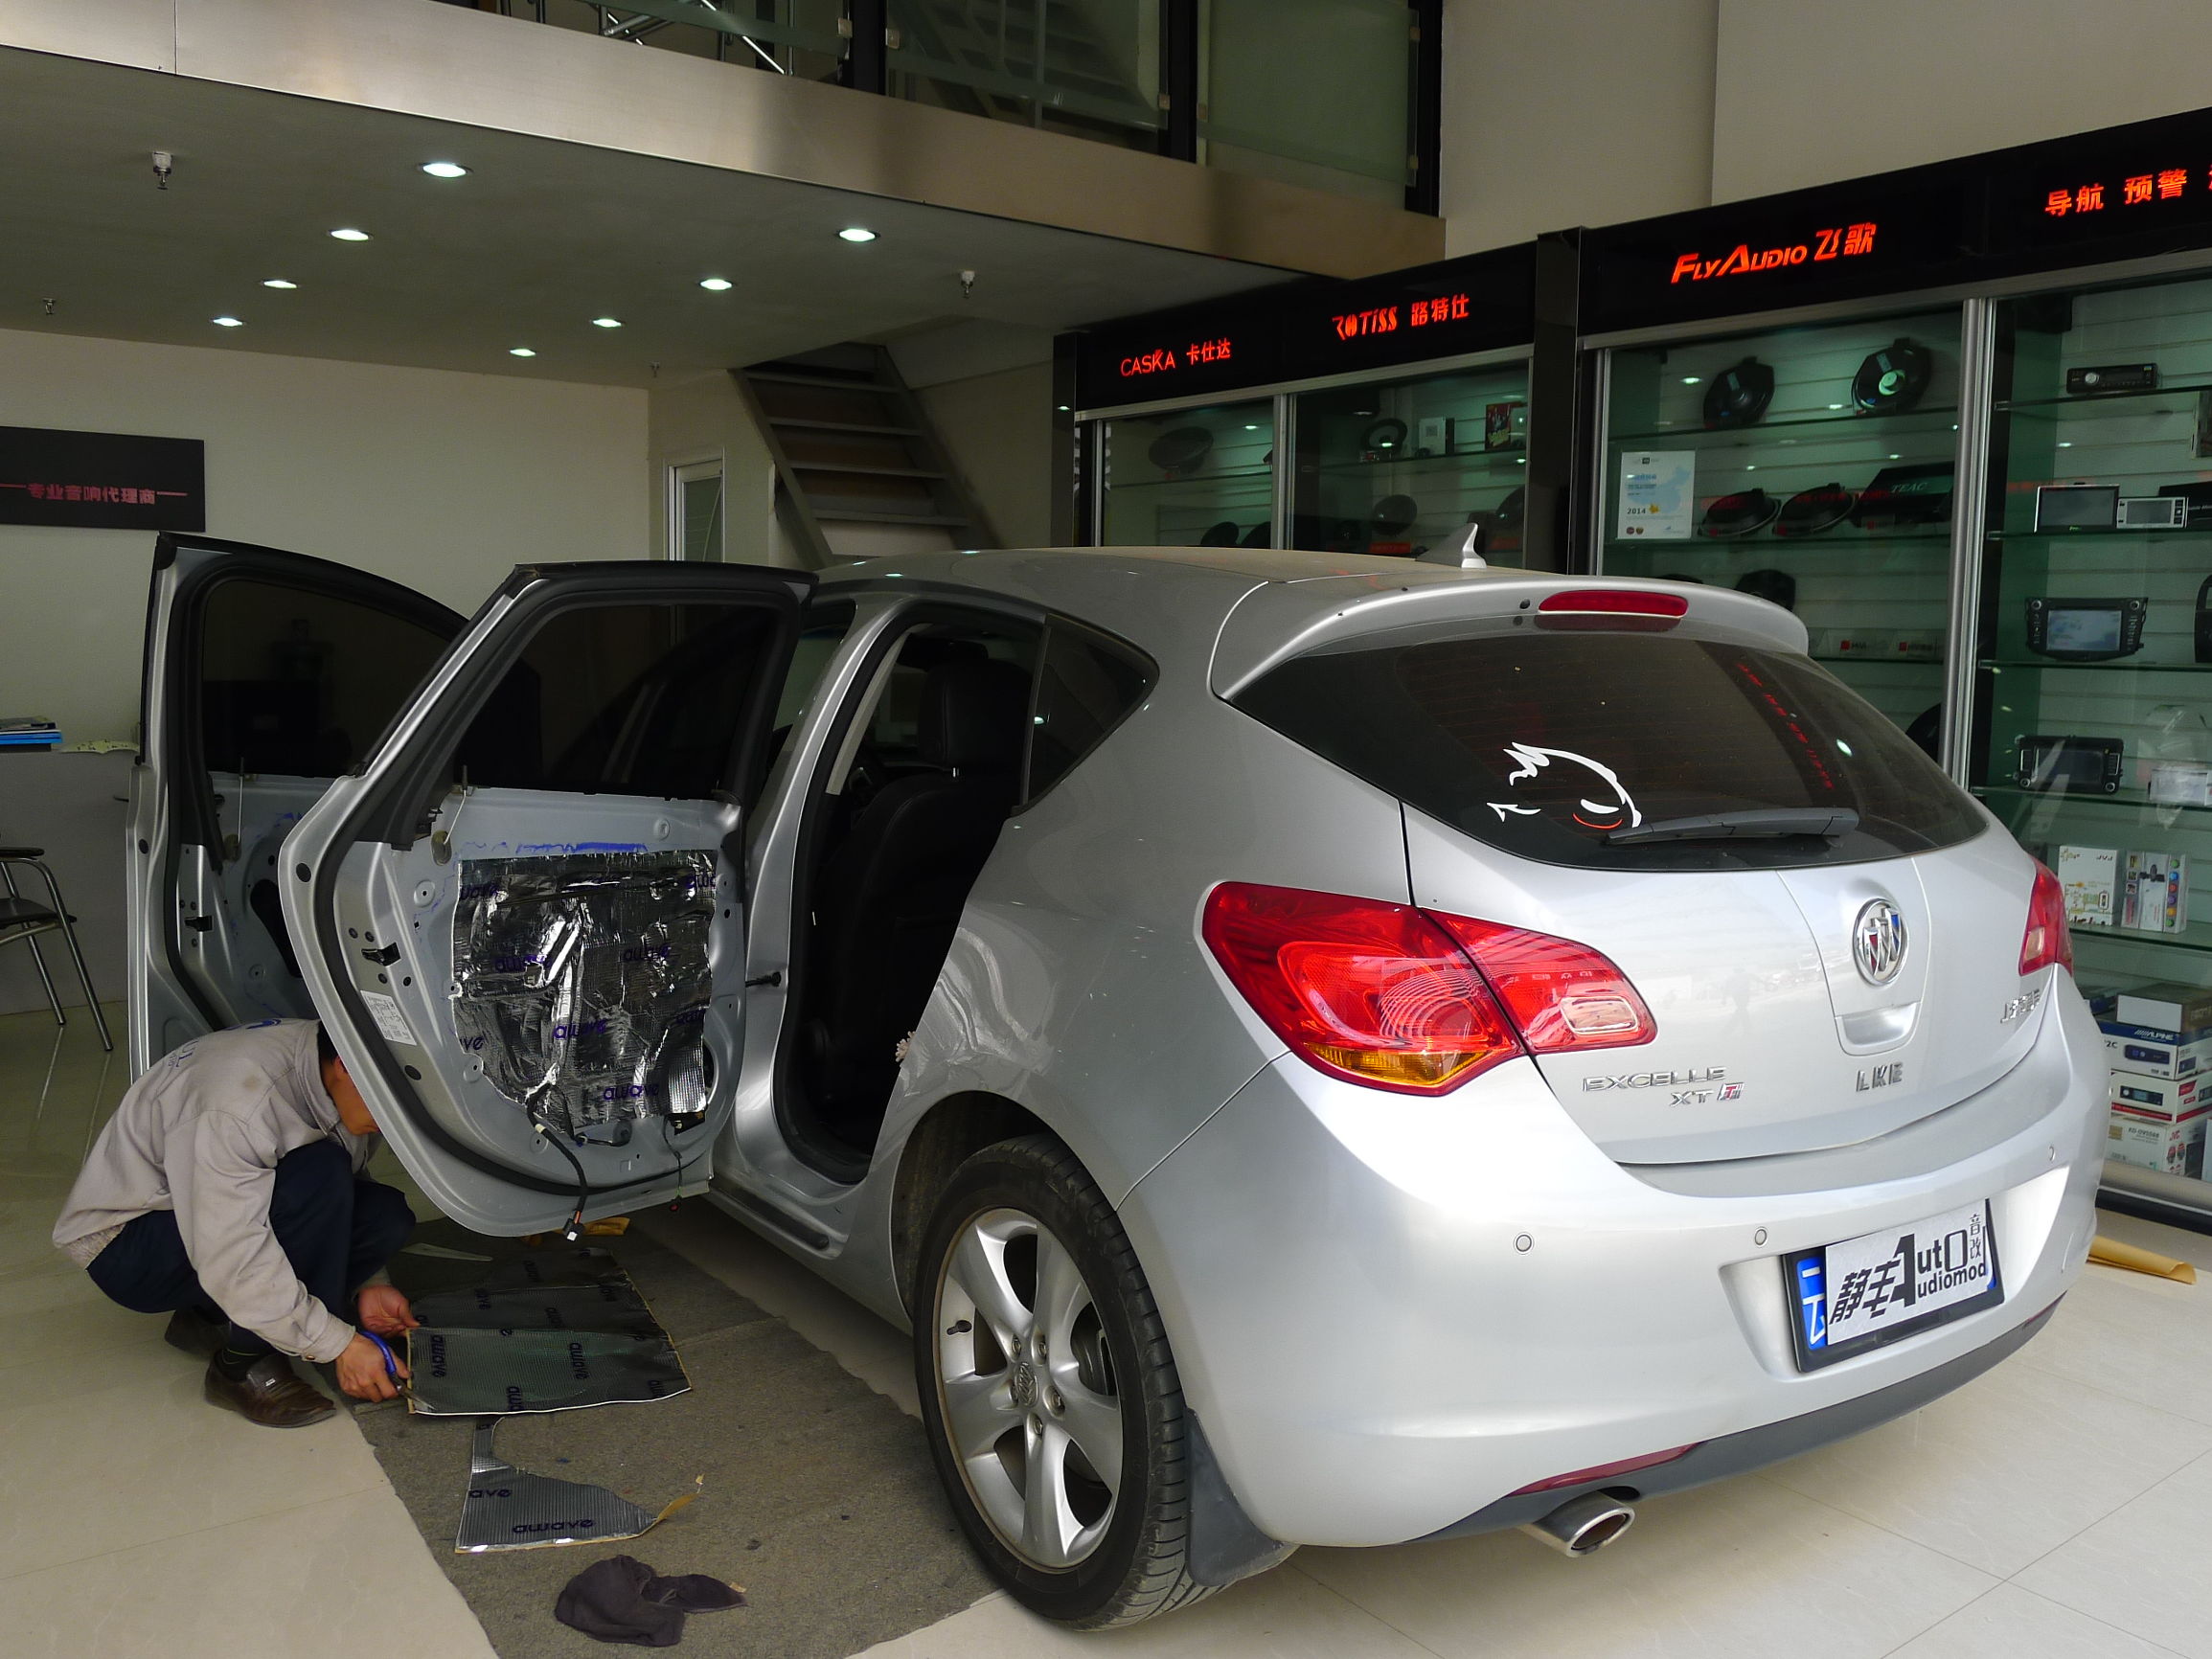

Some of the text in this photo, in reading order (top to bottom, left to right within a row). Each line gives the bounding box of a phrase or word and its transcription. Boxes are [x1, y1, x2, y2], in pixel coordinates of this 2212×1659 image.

[2044, 183, 2105, 216] 导航
[2124, 168, 2188, 205] 预警
[1411, 293, 1470, 327] 路特仕
[1120, 337, 1232, 377] CASKA 卡仕达
[27, 482, 156, 505] 专业音响代理商
[1627, 507, 1647, 515] 2014
[1582, 1066, 1727, 1092] EXCELLE
[513, 1518, 595, 1534] awave
